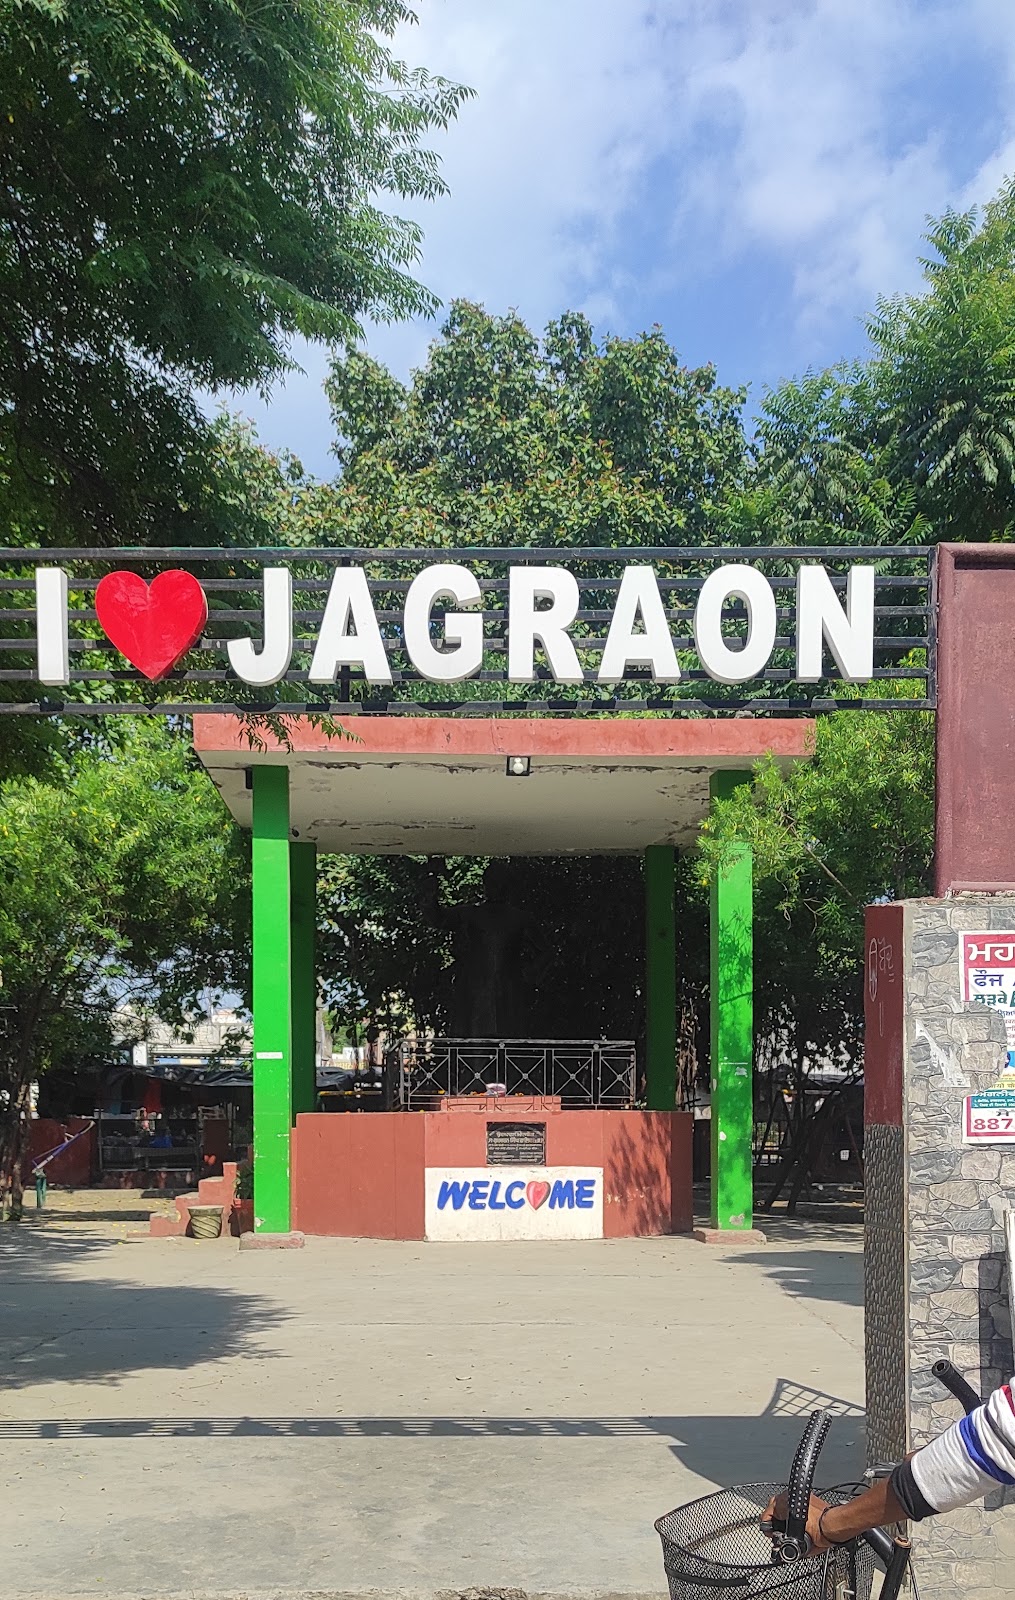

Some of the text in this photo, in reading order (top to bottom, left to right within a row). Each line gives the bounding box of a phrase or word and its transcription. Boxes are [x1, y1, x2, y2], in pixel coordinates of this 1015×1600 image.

[35, 563, 876, 686] I JAGRAON
[973, 1118, 1014, 1131] 887
